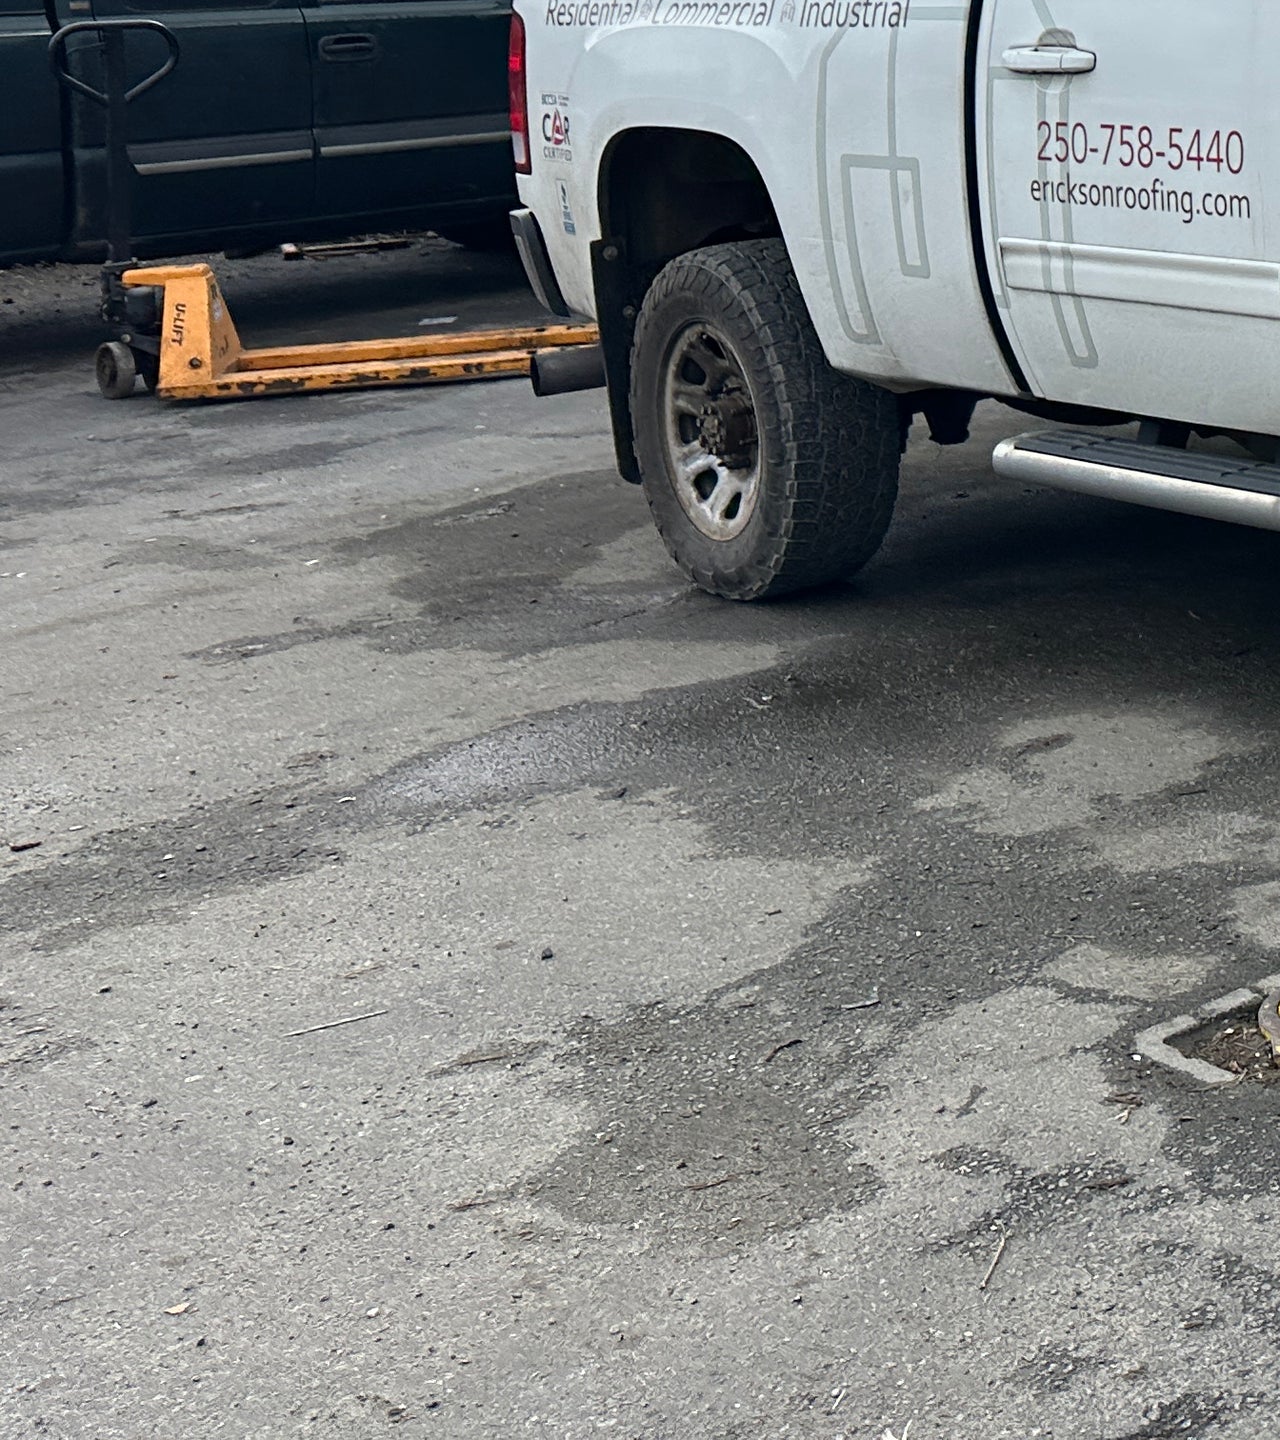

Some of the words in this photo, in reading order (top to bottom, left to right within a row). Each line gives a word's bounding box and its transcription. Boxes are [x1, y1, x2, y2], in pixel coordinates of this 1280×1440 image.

[1037, 120, 1244, 174] 250-758-5440
[1030, 174, 1251, 224] ericksonroofing.com
[171, 303, 186, 346] U-LIFT
